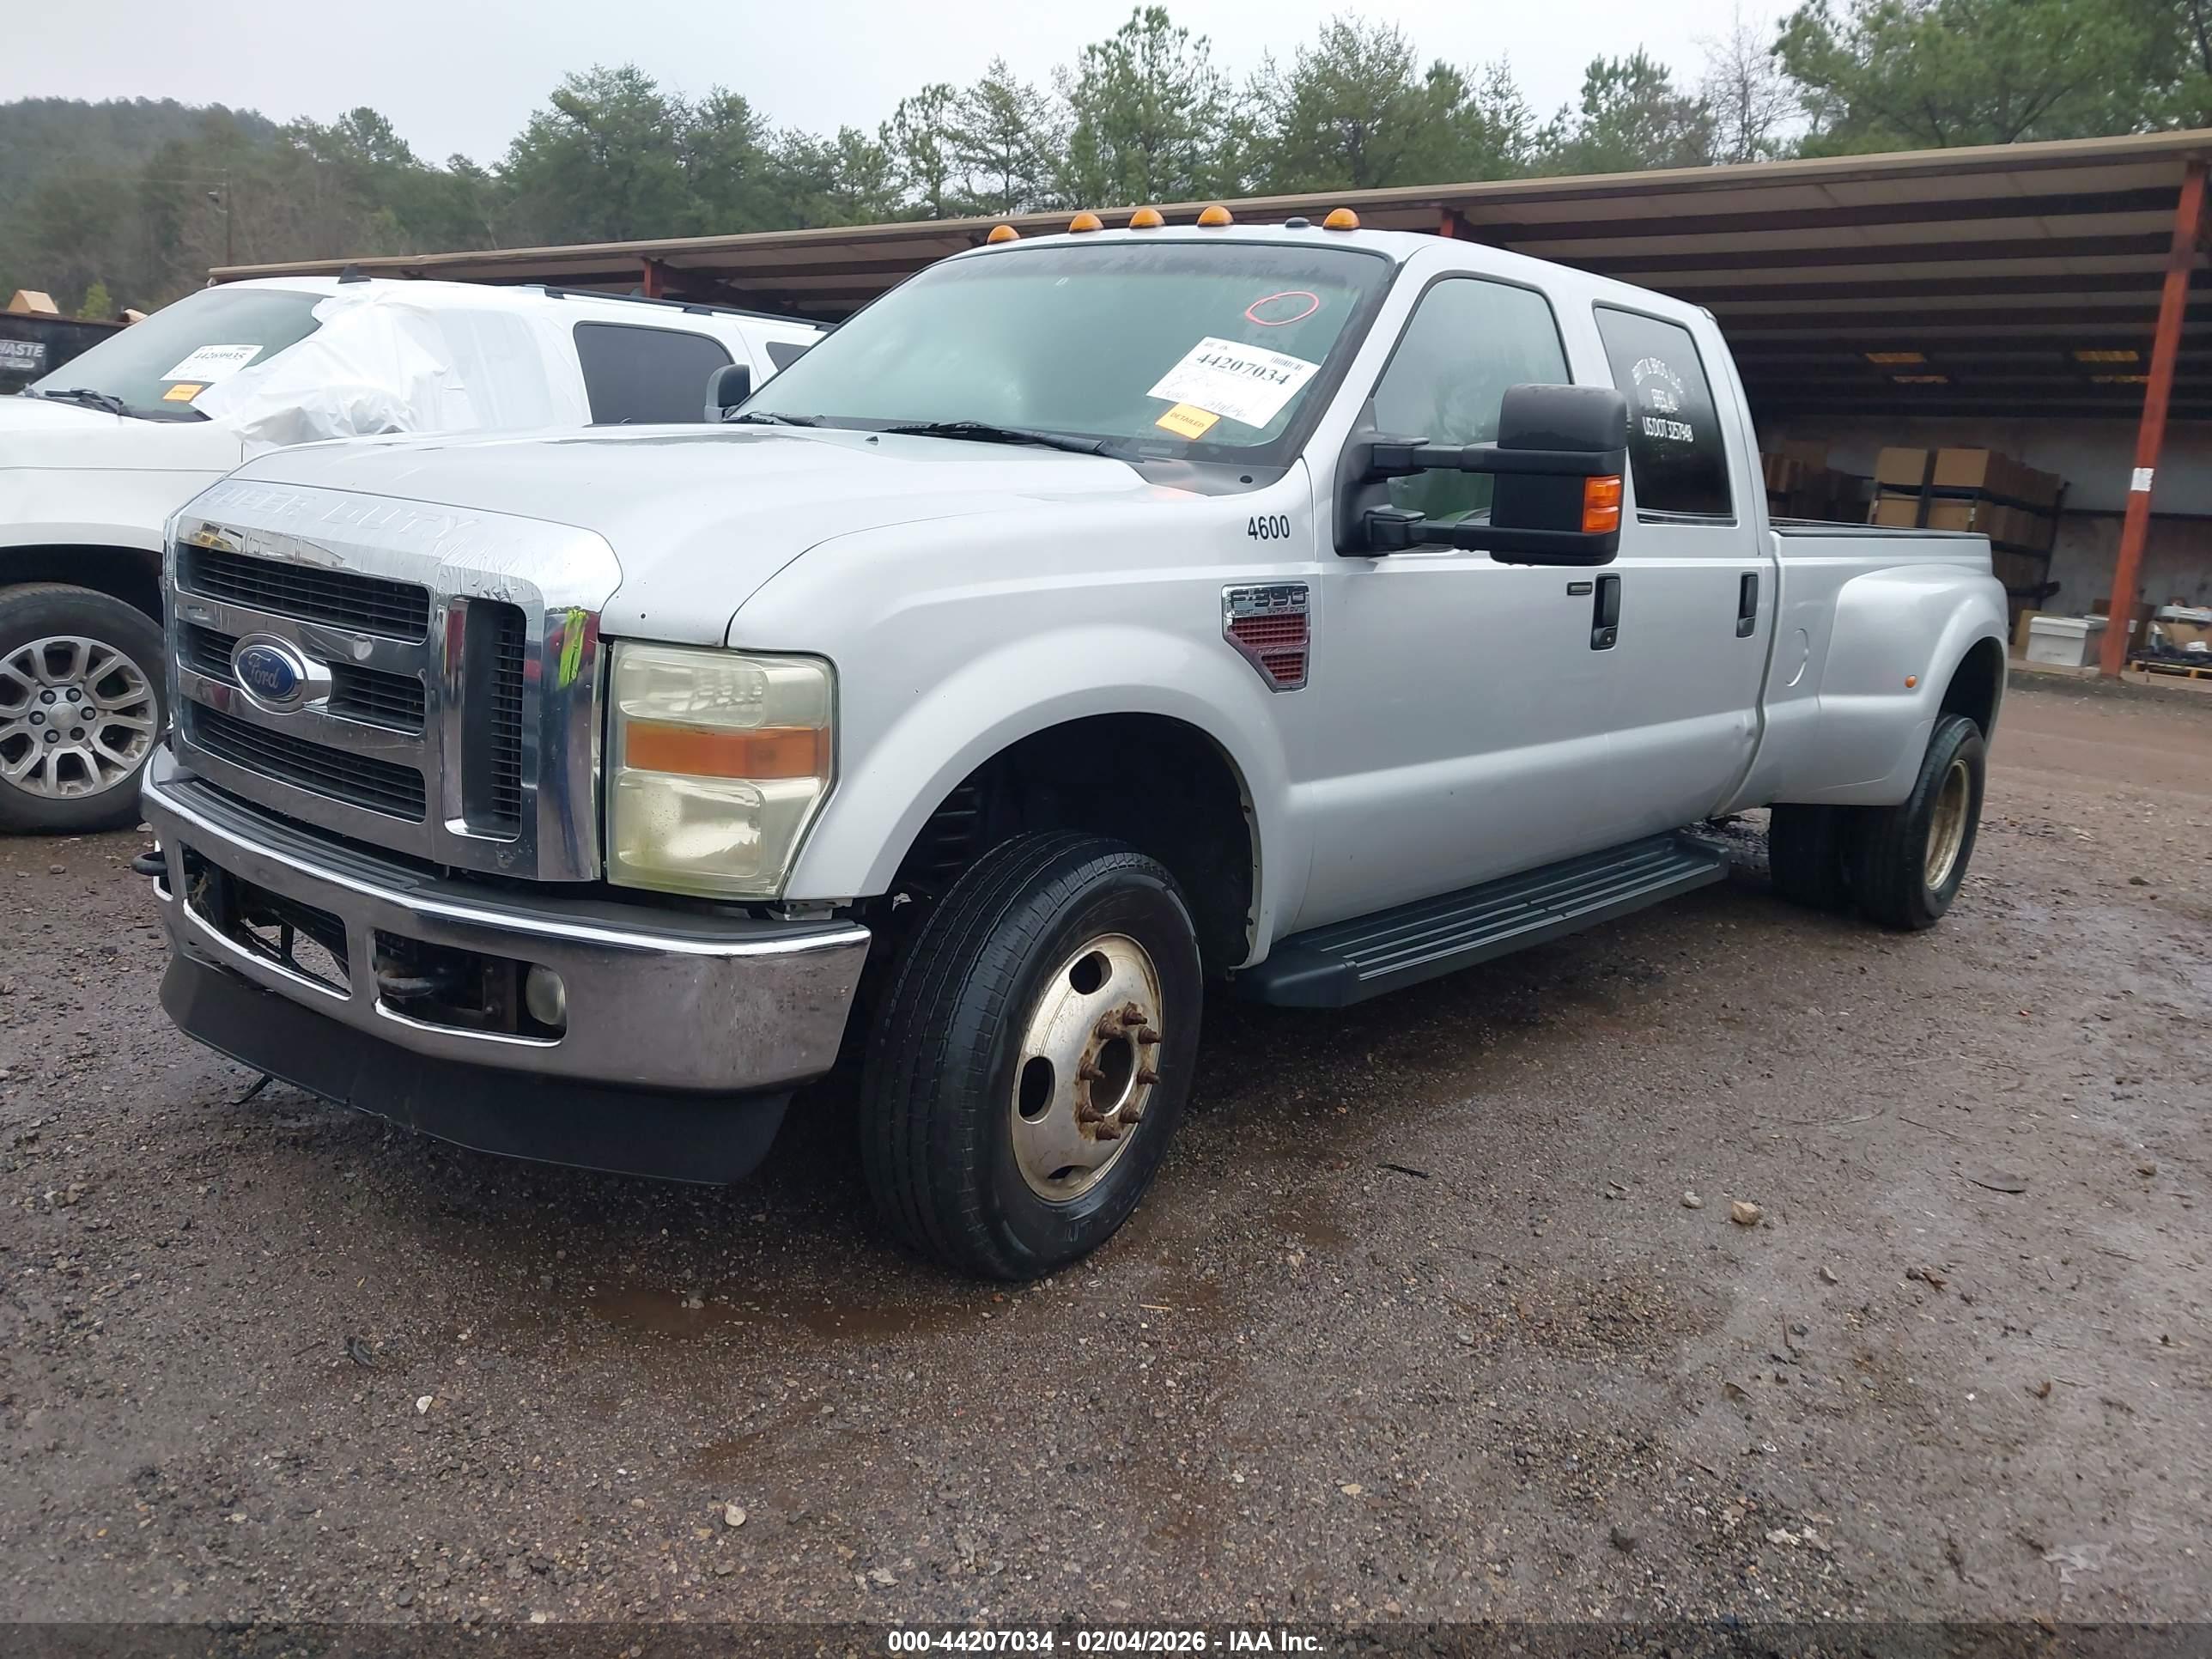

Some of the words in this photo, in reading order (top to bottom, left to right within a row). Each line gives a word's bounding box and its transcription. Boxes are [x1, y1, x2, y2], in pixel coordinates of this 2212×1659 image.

[1197, 353, 1291, 385] 44207034
[1170, 412, 1205, 428] DETAILED
[197, 486, 317, 515] SUPER
[321, 501, 480, 539] DUTY
[1248, 514, 1290, 540] 4600
[248, 652, 280, 689] Ford
